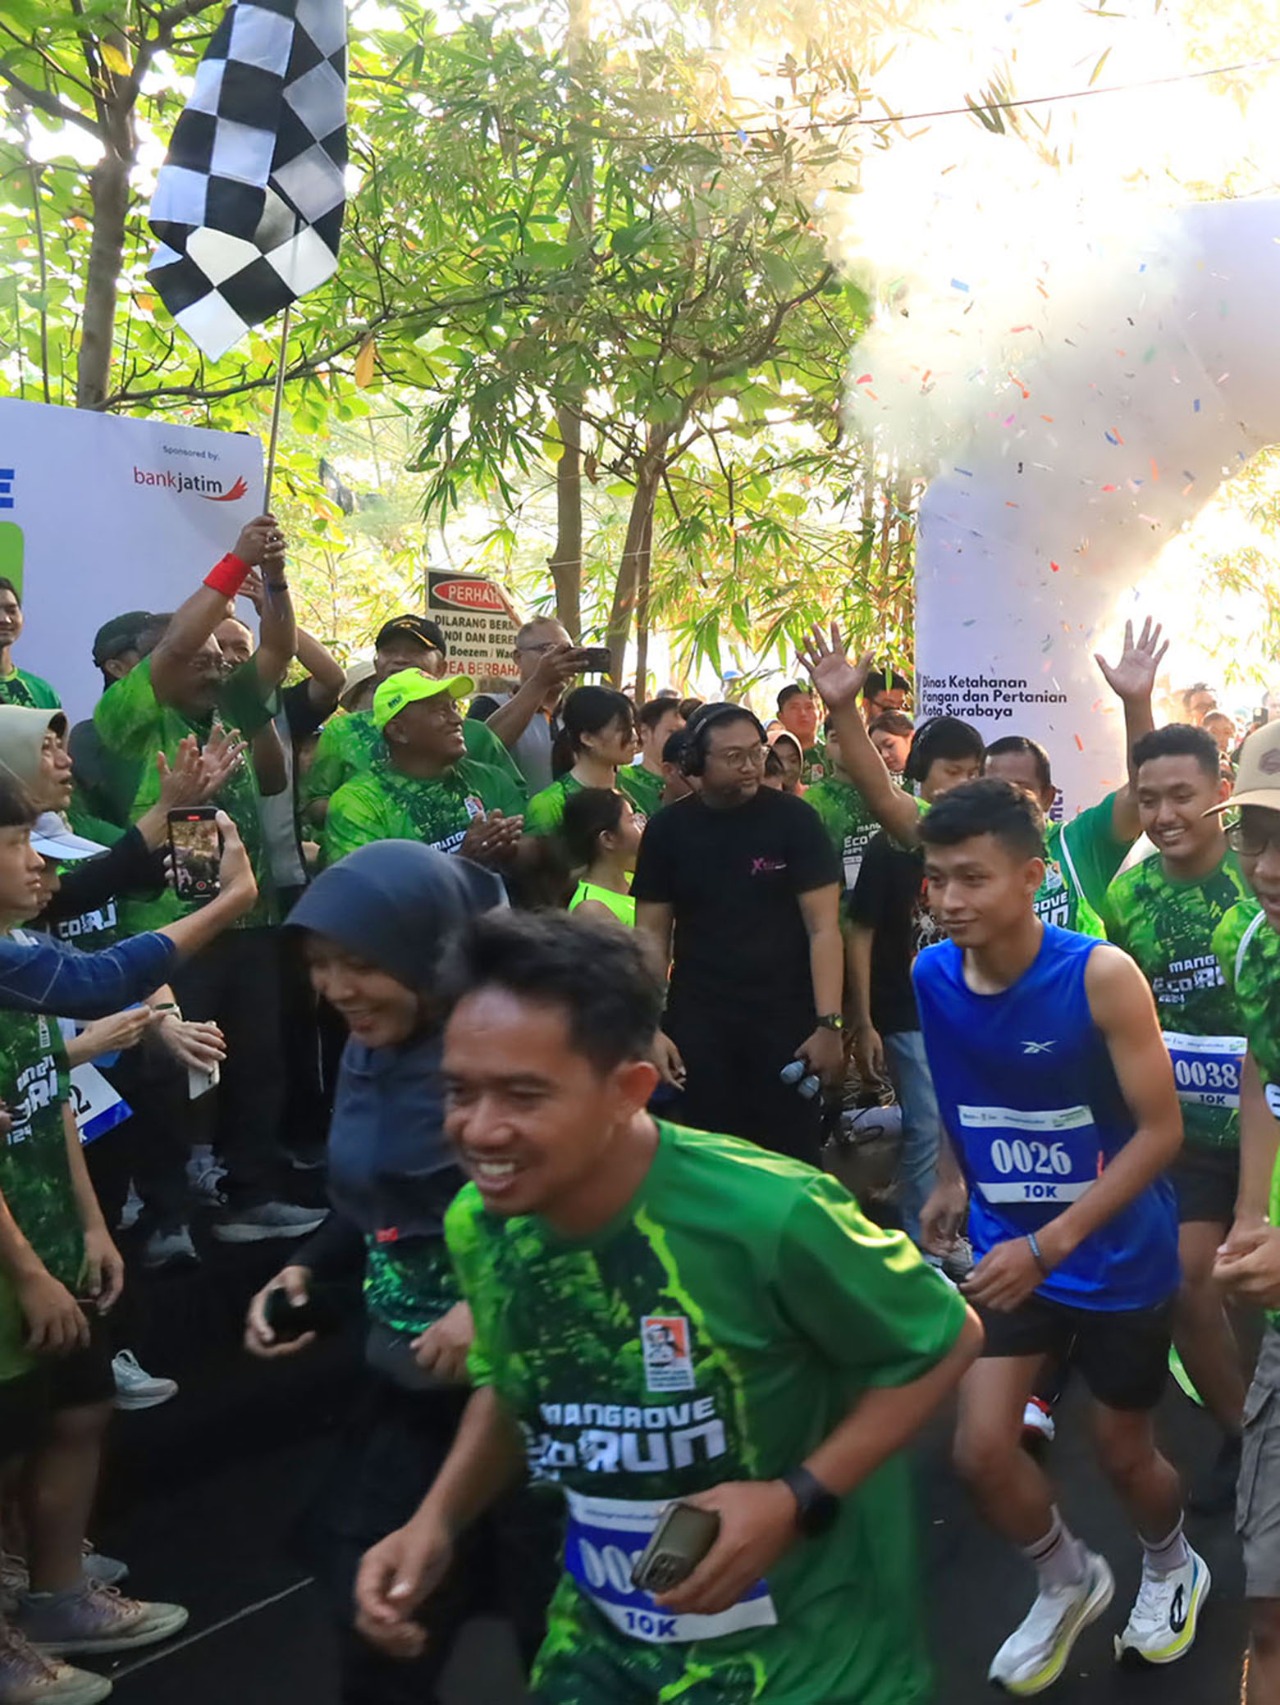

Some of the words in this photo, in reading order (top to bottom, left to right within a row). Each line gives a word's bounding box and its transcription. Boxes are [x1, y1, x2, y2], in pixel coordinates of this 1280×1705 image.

[163, 445, 207, 460] Sponsored
[133, 466, 224, 493] bankjatim
[434, 615, 487, 630] DILARANG
[465, 632, 486, 644] DAN
[449, 645, 488, 659] Boezem
[922, 676, 947, 689] Dinas
[949, 674, 1027, 689] Ketahanan
[922, 689, 960, 705] Pangan
[962, 689, 989, 703] dan
[993, 689, 1067, 704] Pertanian
[922, 704, 943, 717] Kota
[945, 703, 1013, 721] Surabaya
[1175, 1060, 1239, 1090] 0038
[1199, 1094, 1226, 1106] 10K
[991, 1138, 1073, 1176] 0026
[1023, 1184, 1058, 1199] 10K
[624, 1611, 678, 1637] 10K
